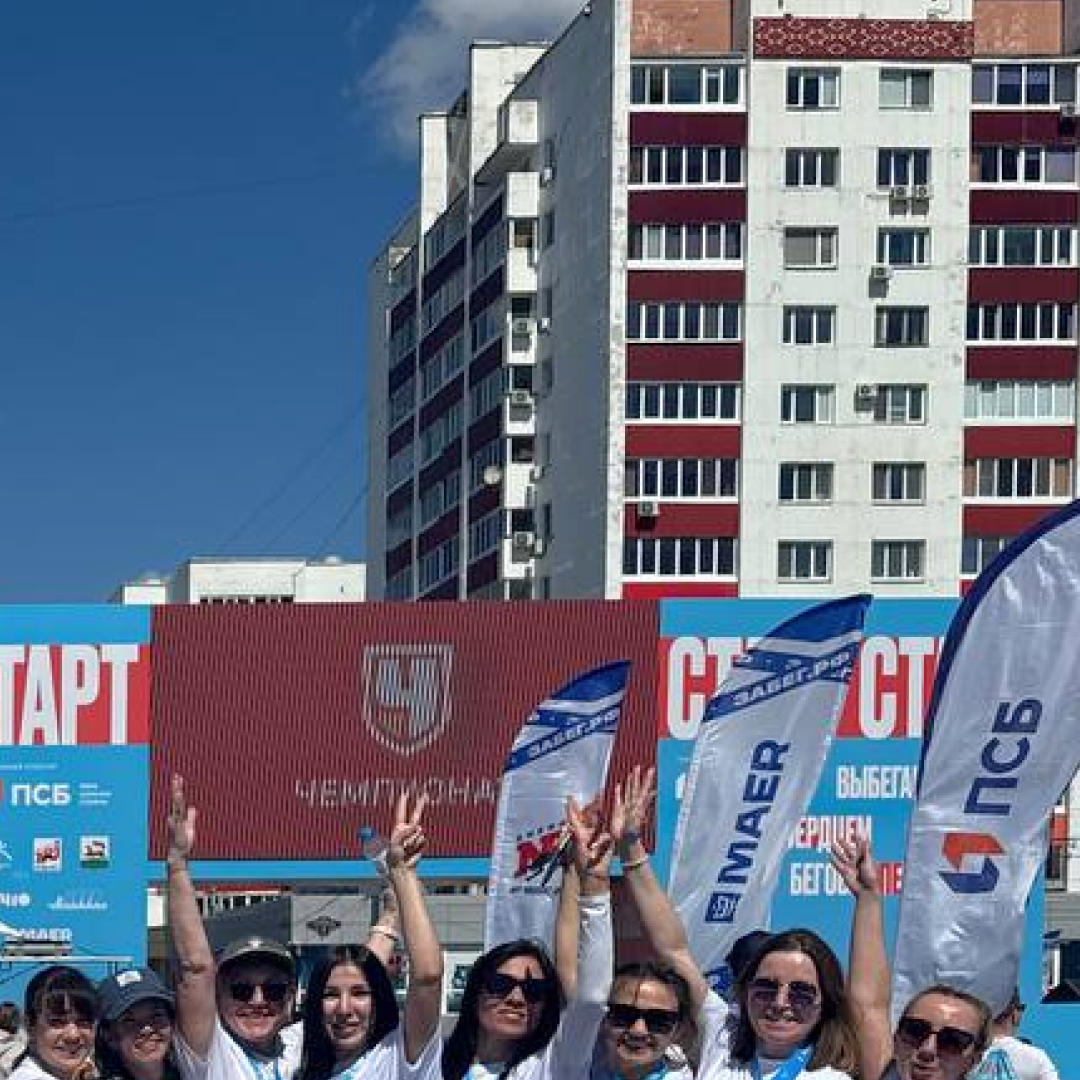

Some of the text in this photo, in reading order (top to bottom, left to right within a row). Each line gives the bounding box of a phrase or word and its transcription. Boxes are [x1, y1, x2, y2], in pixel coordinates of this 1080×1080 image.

[667, 635, 763, 739] СТ
[859, 635, 944, 739] СТ
[11, 783, 71, 807] ПСБ
[964, 697, 1043, 814] ПСБ
[717, 739, 790, 884] MAER
[788, 815, 872, 854] ЕРДЦЕМ
